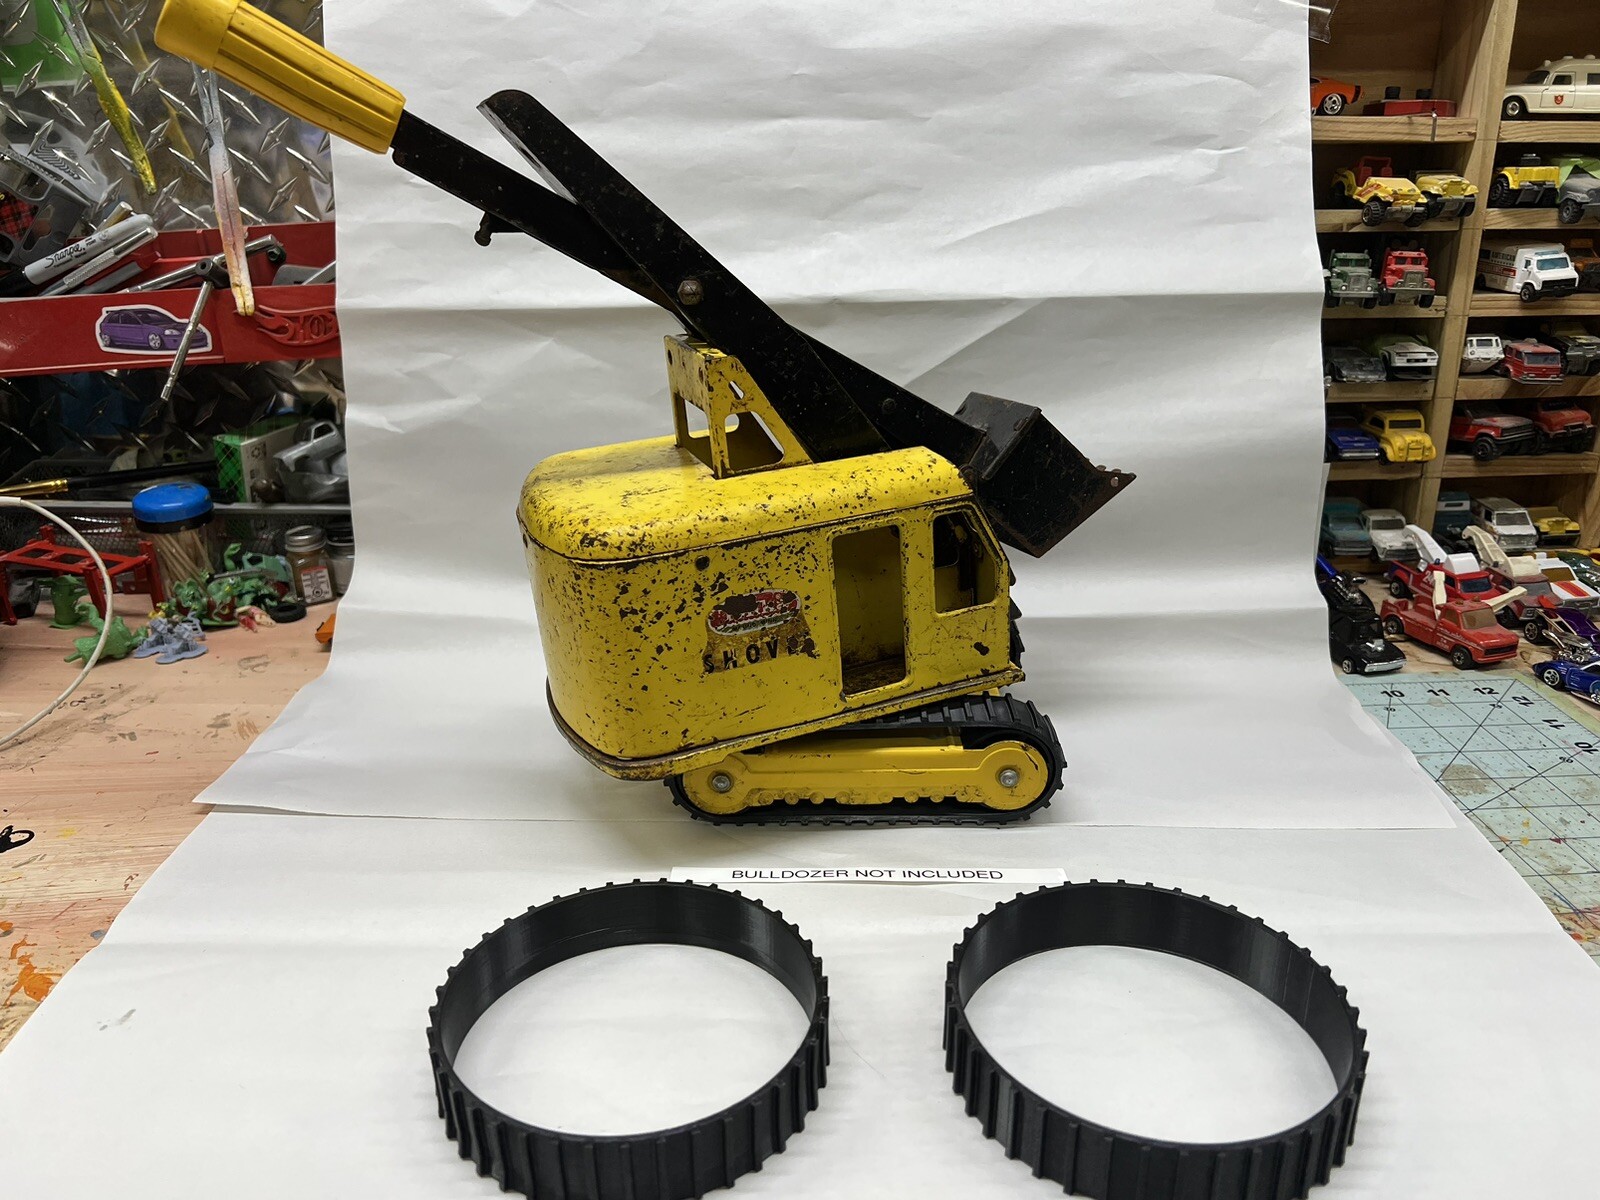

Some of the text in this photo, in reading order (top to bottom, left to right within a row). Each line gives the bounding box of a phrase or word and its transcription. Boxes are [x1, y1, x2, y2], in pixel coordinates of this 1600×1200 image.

[703, 637, 815, 674] SHOV
[1380, 689, 1405, 698] 10
[1427, 689, 1451, 697] 11
[1473, 687, 1500, 695] 12
[1511, 695, 1535, 708] 12
[1541, 719, 1566, 730] 11
[1574, 742, 1599, 755] 10
[732, 869, 1004, 880] BULLDOZER NOT INCLUDED
